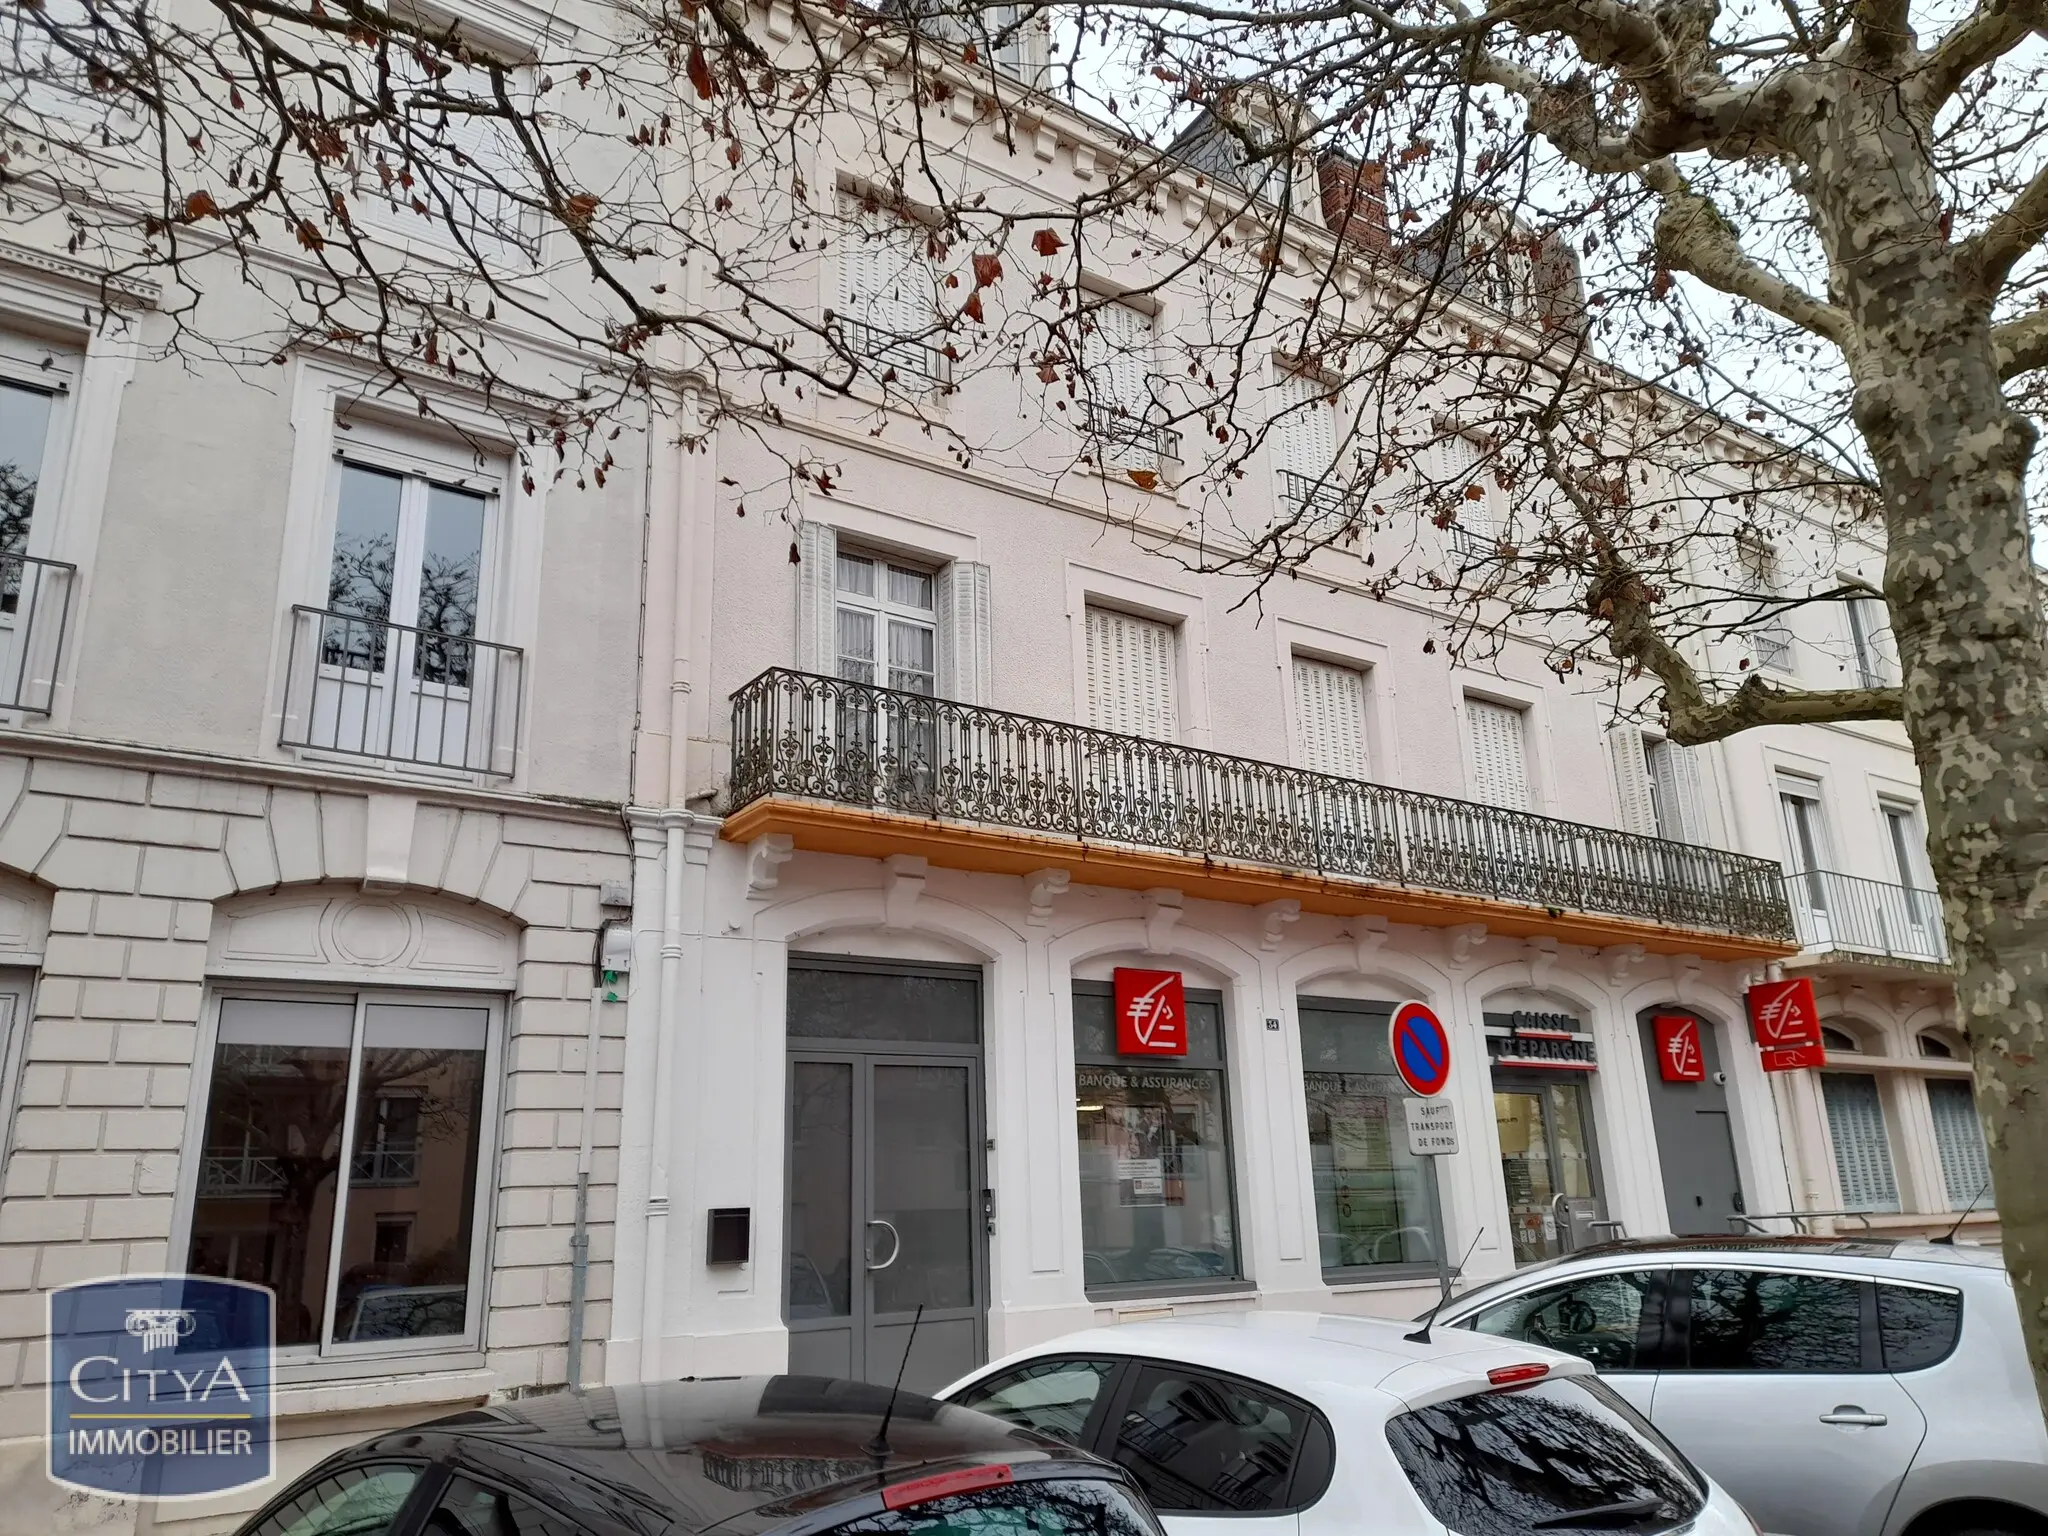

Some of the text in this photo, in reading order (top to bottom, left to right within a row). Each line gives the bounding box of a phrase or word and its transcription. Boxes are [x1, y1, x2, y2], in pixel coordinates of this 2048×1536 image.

[1513, 1010, 1570, 1031] CAISSE
[1079, 1074, 1211, 1089] BANQUE & ASSURANCES
[1420, 1106, 1439, 1116] SAUF
[1411, 1121, 1453, 1131] TRANSPORT
[1418, 1136, 1455, 1147] DE FONDS
